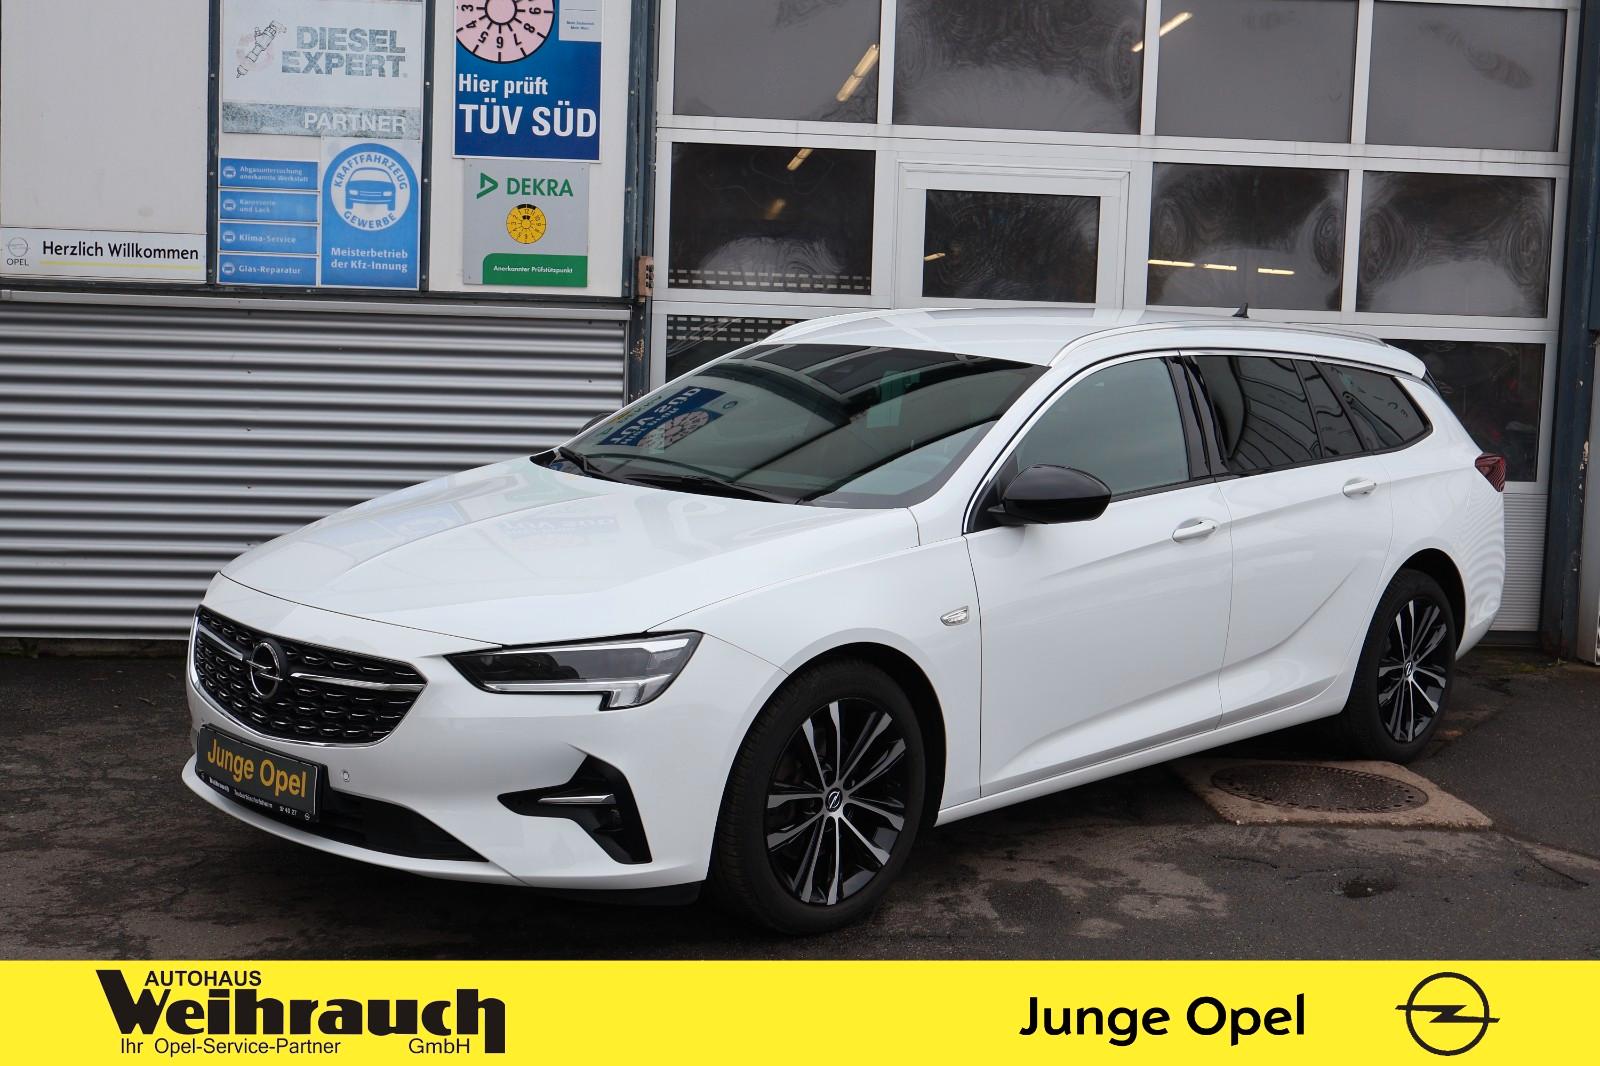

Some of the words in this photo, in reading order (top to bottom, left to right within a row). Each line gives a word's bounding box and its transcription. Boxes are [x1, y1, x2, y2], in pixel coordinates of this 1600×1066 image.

[296, 25, 406, 54] DIESEL
[281, 50, 406, 78] EXPERT
[458, 73, 499, 93] Hier
[504, 76, 549, 99] prüft
[304, 112, 406, 133] PARTNER
[458, 97, 523, 135] TÜV
[531, 100, 597, 138] SÜD
[333, 153, 408, 190] KRAFTFAHRZEUG
[506, 177, 574, 197] DEKRA
[343, 210, 397, 229] GEWERBE
[239, 232, 297, 244] Klima-Service
[42, 240, 104, 257] Herzlich
[108, 242, 199, 260] Willkommen
[331, 247, 408, 259] Meisterbetrieb
[6, 258, 29, 267] OPEL
[238, 264, 301, 275] Glas-Reparatur
[330, 259, 349, 269] der
[350, 260, 408, 273] Kfz-Innung
[531, 266, 573, 274] Prüfstützpunkt
[207, 738, 255, 783] Junge
[259, 759, 307, 798] Opel
